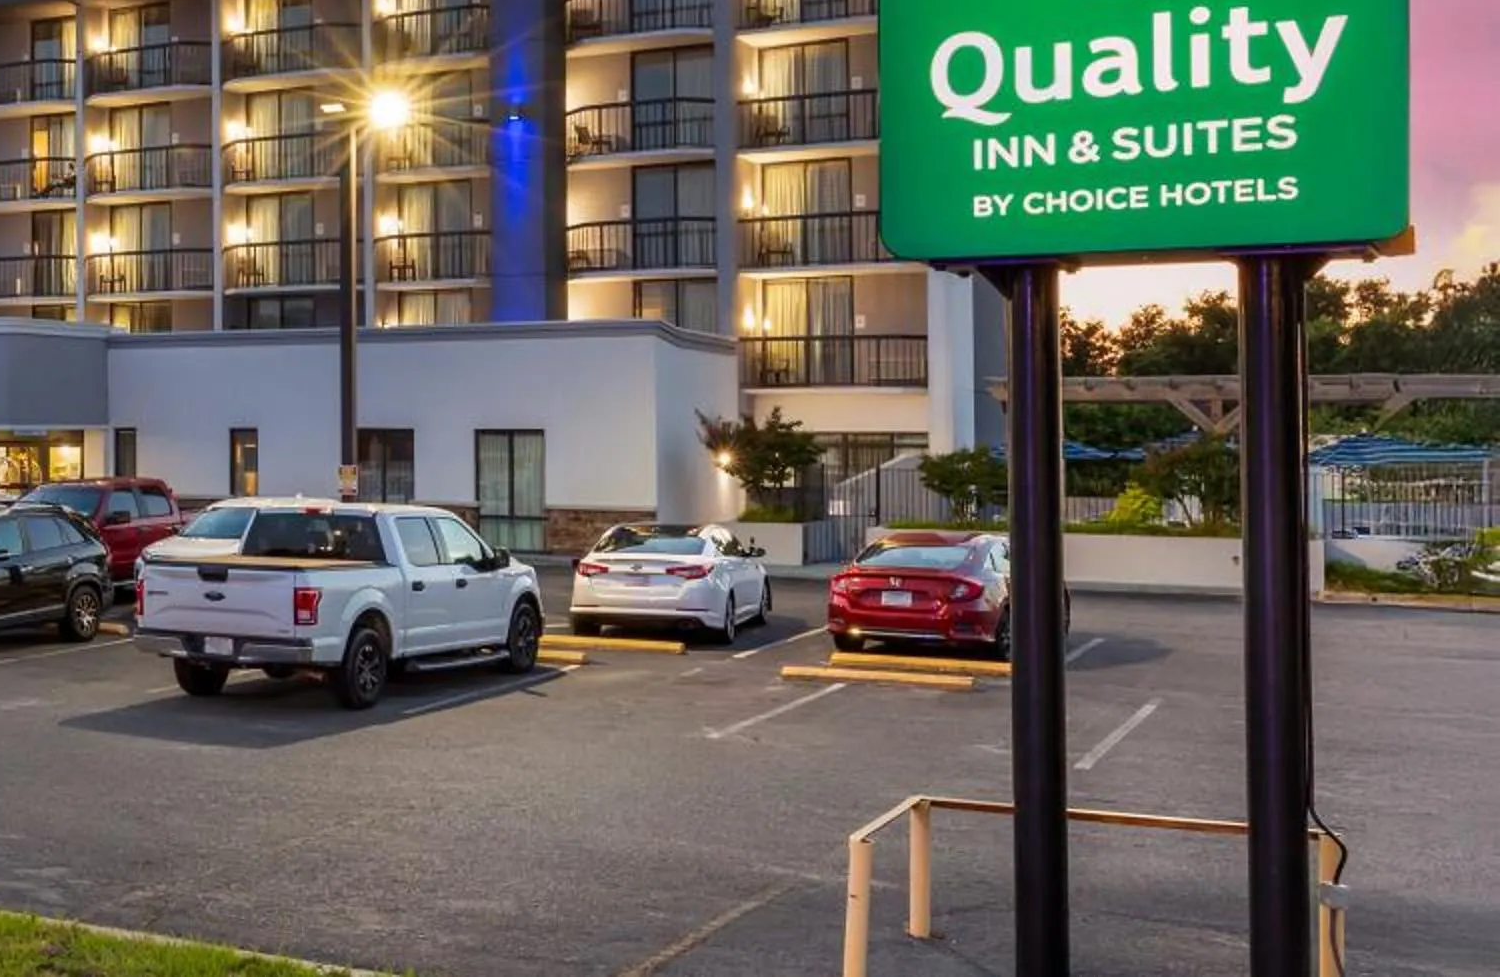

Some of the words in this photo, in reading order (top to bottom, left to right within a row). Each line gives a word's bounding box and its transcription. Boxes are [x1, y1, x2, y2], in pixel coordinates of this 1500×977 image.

[929, 5, 1349, 126] Quality
[972, 134, 1056, 171] INN
[1067, 130, 1100, 164] &
[1112, 114, 1298, 161] SUITES
[972, 194, 1013, 218] BY
[1023, 186, 1149, 216] CHOICE
[1160, 177, 1298, 207] HOTELS
